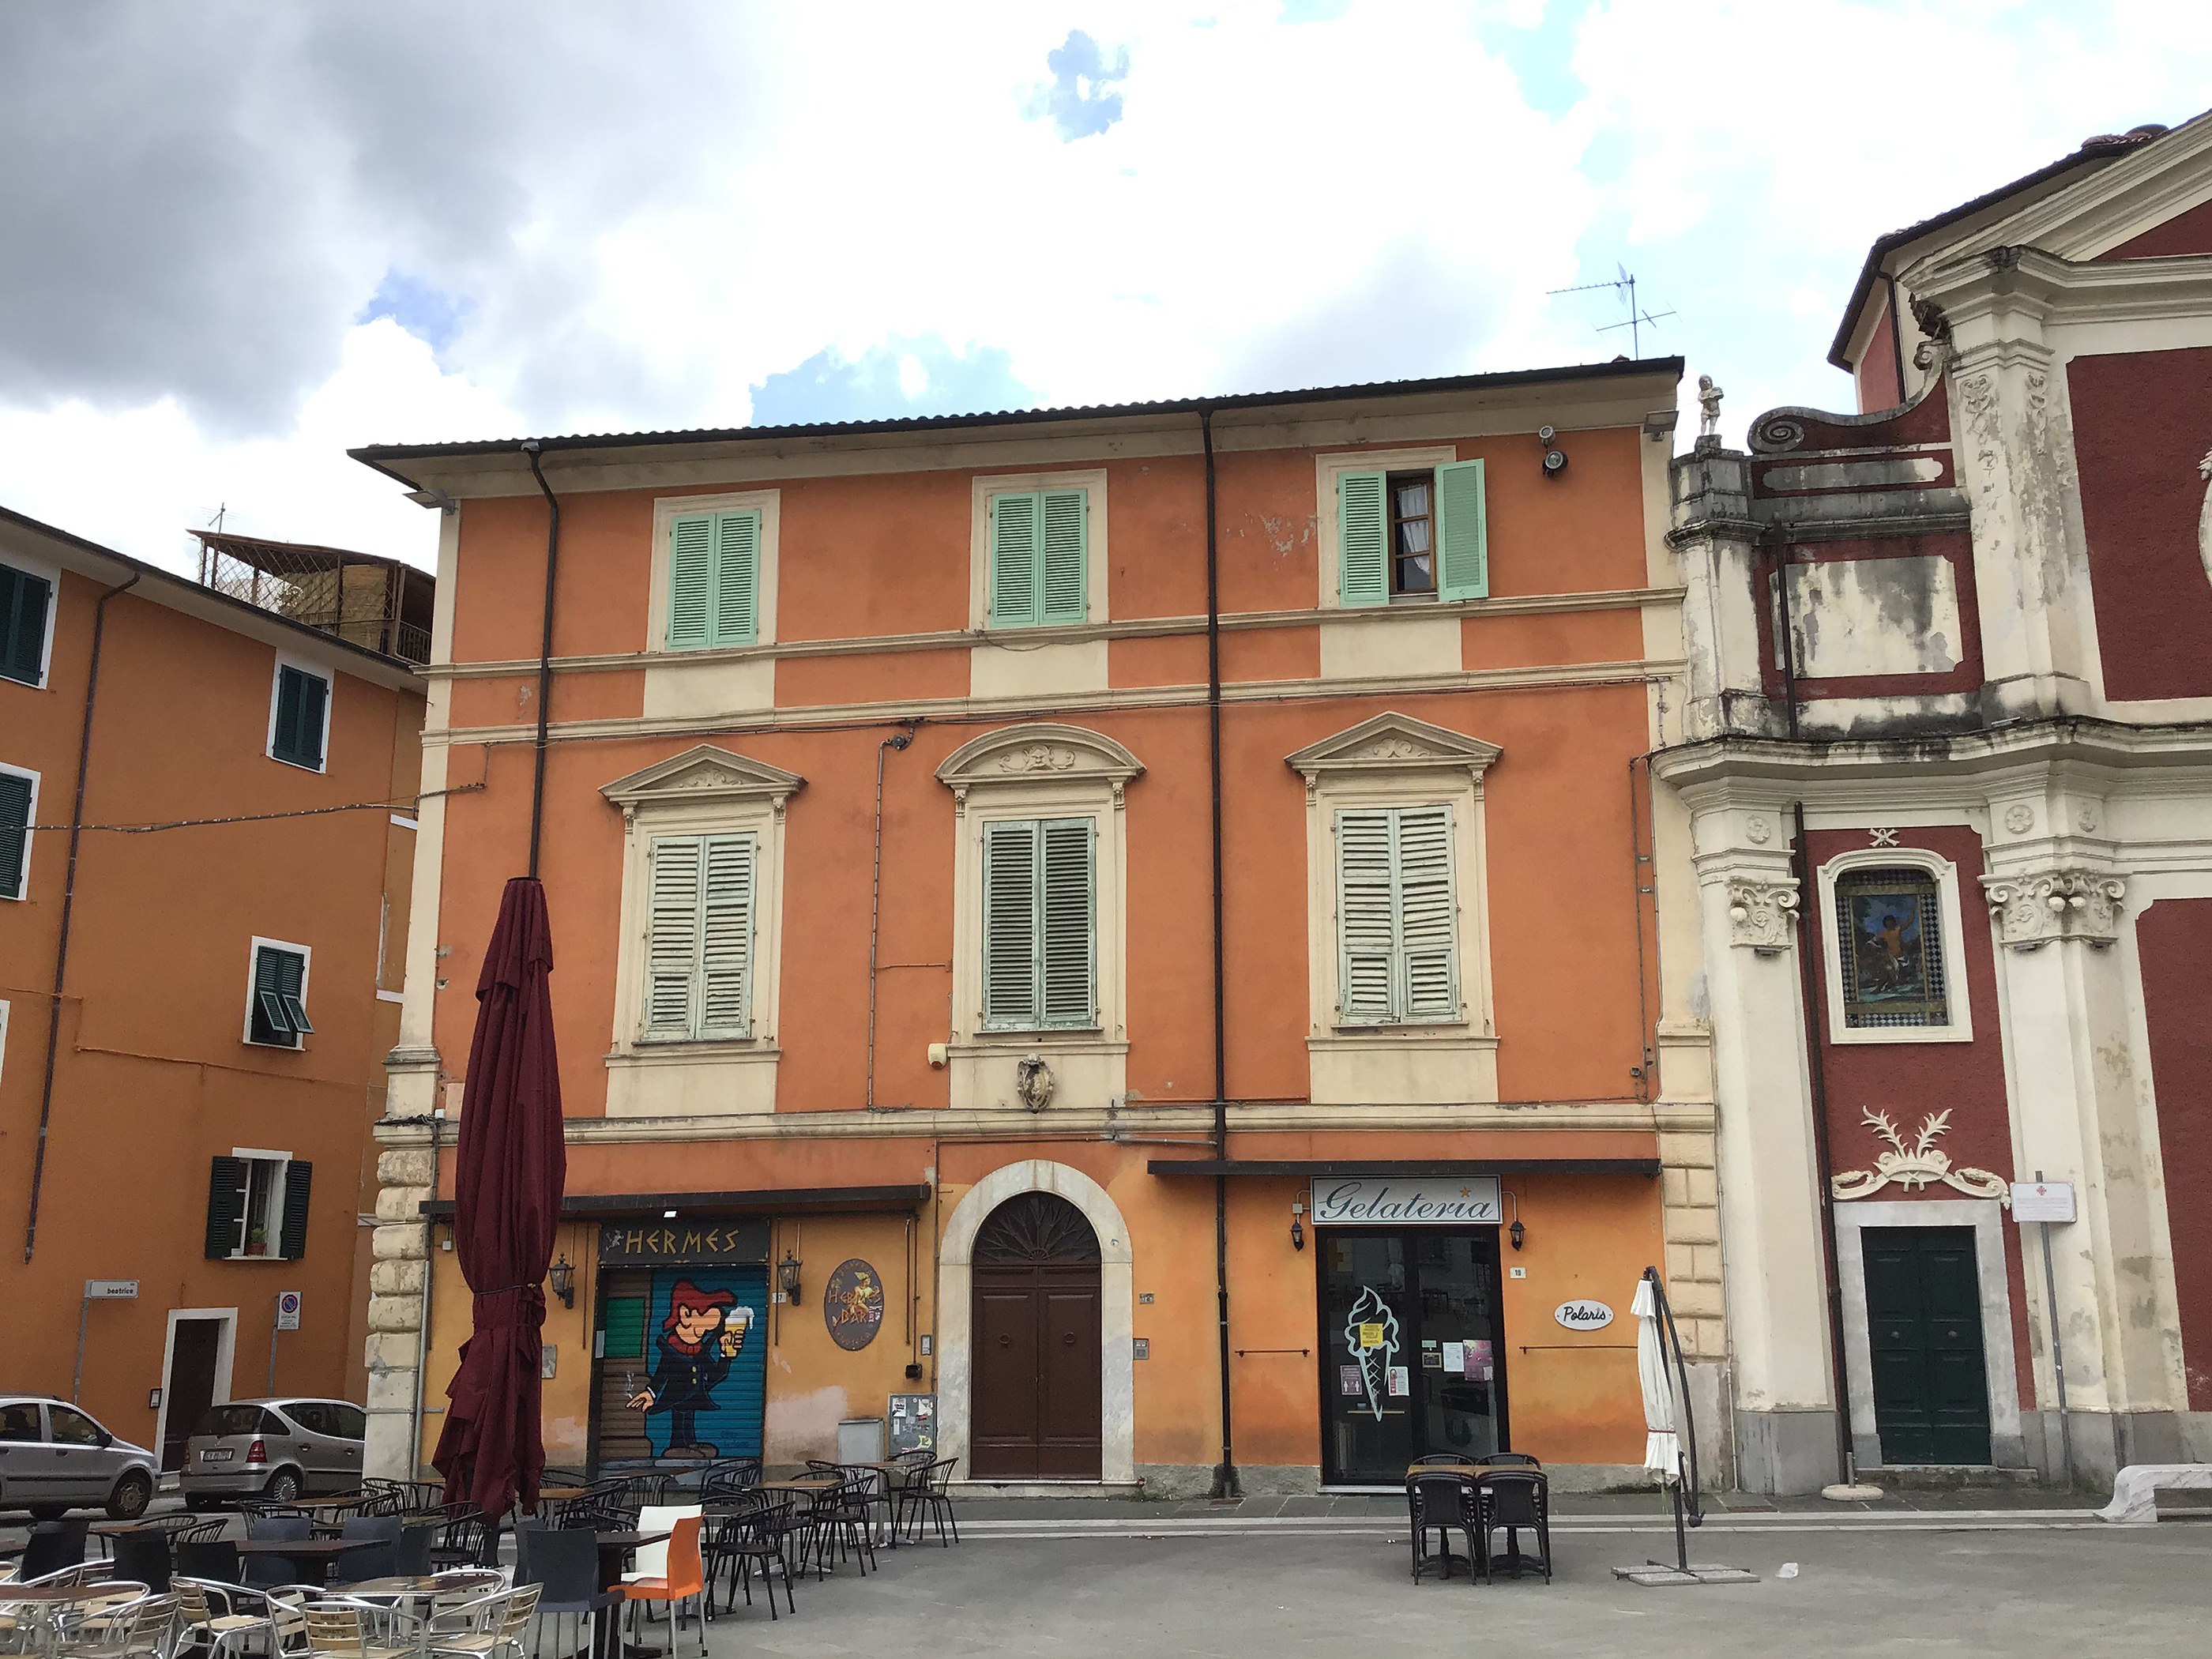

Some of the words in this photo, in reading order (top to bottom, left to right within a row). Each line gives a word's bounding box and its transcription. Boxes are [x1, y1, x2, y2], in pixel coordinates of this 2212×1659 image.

[1319, 1182, 1493, 1219] Gelateria
[625, 1228, 739, 1255] HERMES
[1563, 1305, 1606, 1322] Polaris
